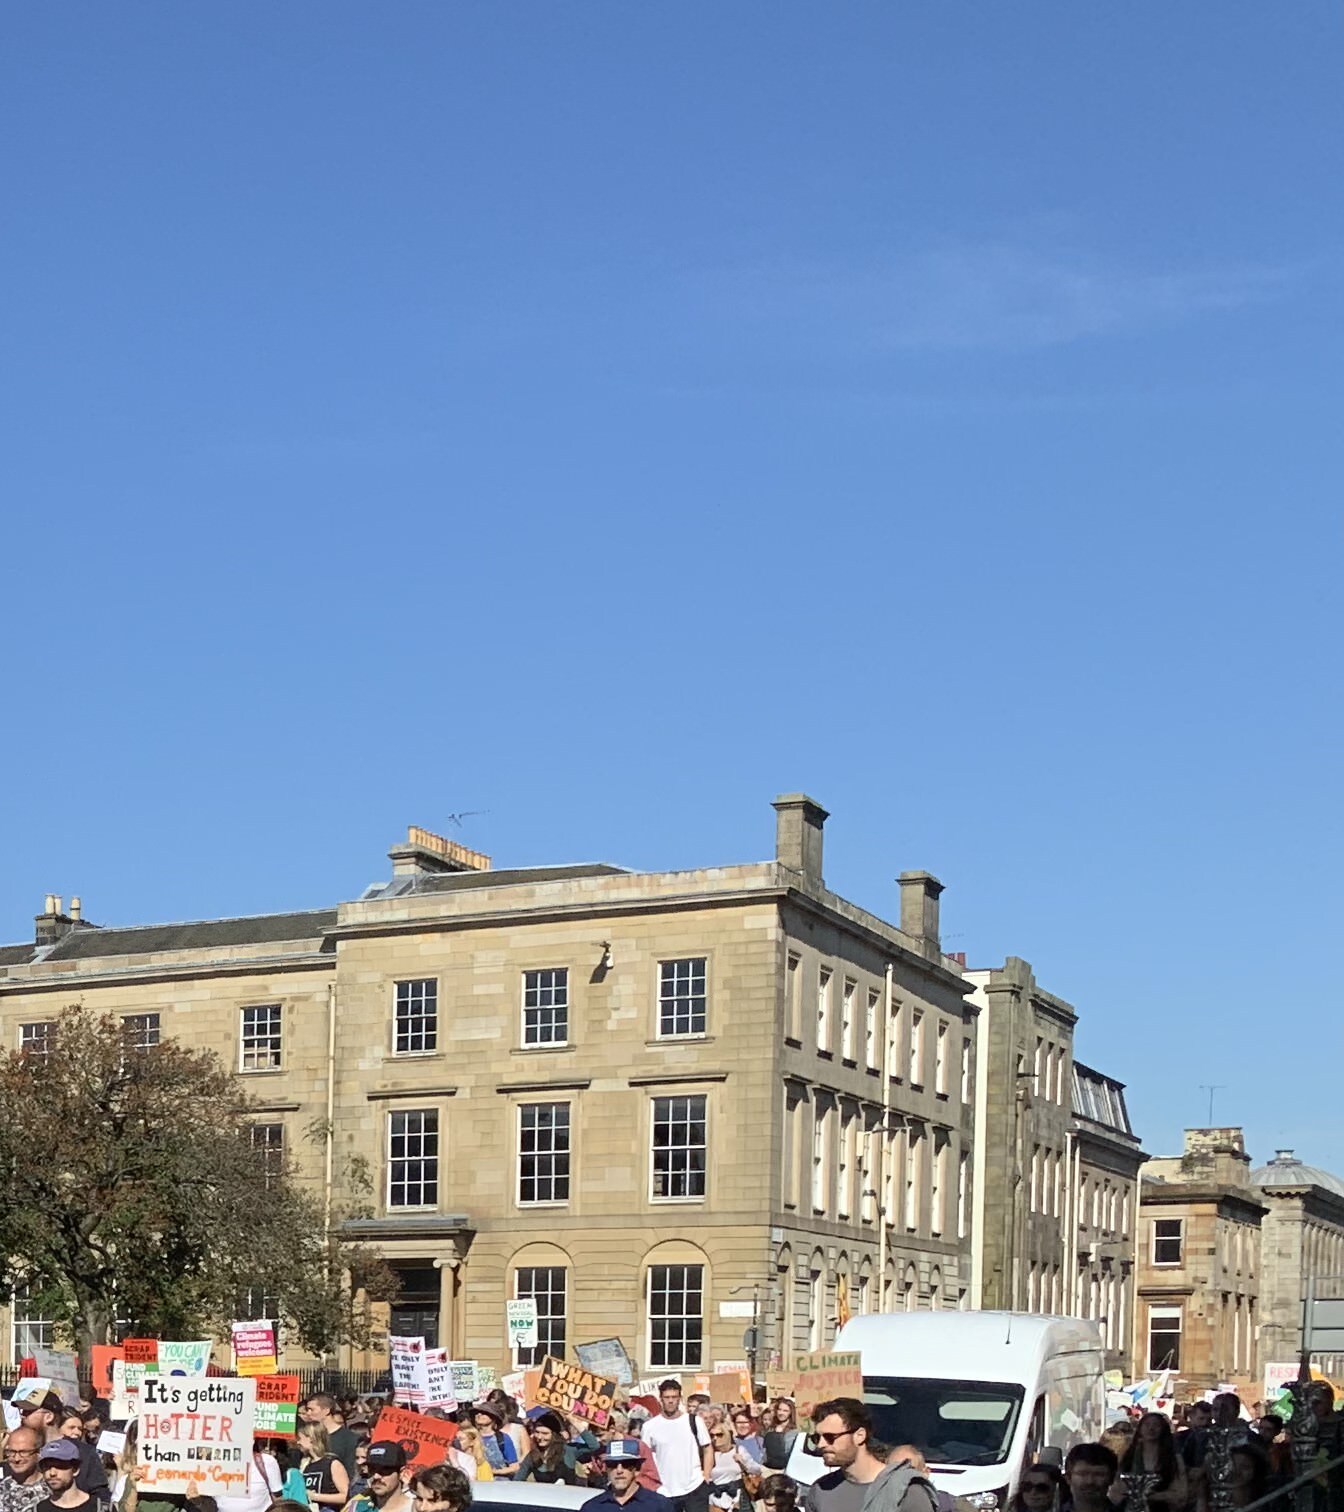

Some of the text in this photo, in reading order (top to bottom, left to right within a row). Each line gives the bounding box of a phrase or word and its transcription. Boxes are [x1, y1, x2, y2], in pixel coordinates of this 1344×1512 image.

[510, 1319, 534, 1329] NOW
[544, 1373, 583, 1399] YOU
[583, 1387, 611, 1410] DO
[551, 1361, 607, 1394] WHAT
[144, 1379, 182, 1404] It's
[186, 1383, 244, 1415] getting
[535, 1386, 608, 1424] COUNTS
[143, 1412, 233, 1442] HOTTER
[395, 1424, 450, 1448] EXISTENCE
[142, 1443, 181, 1462] than
